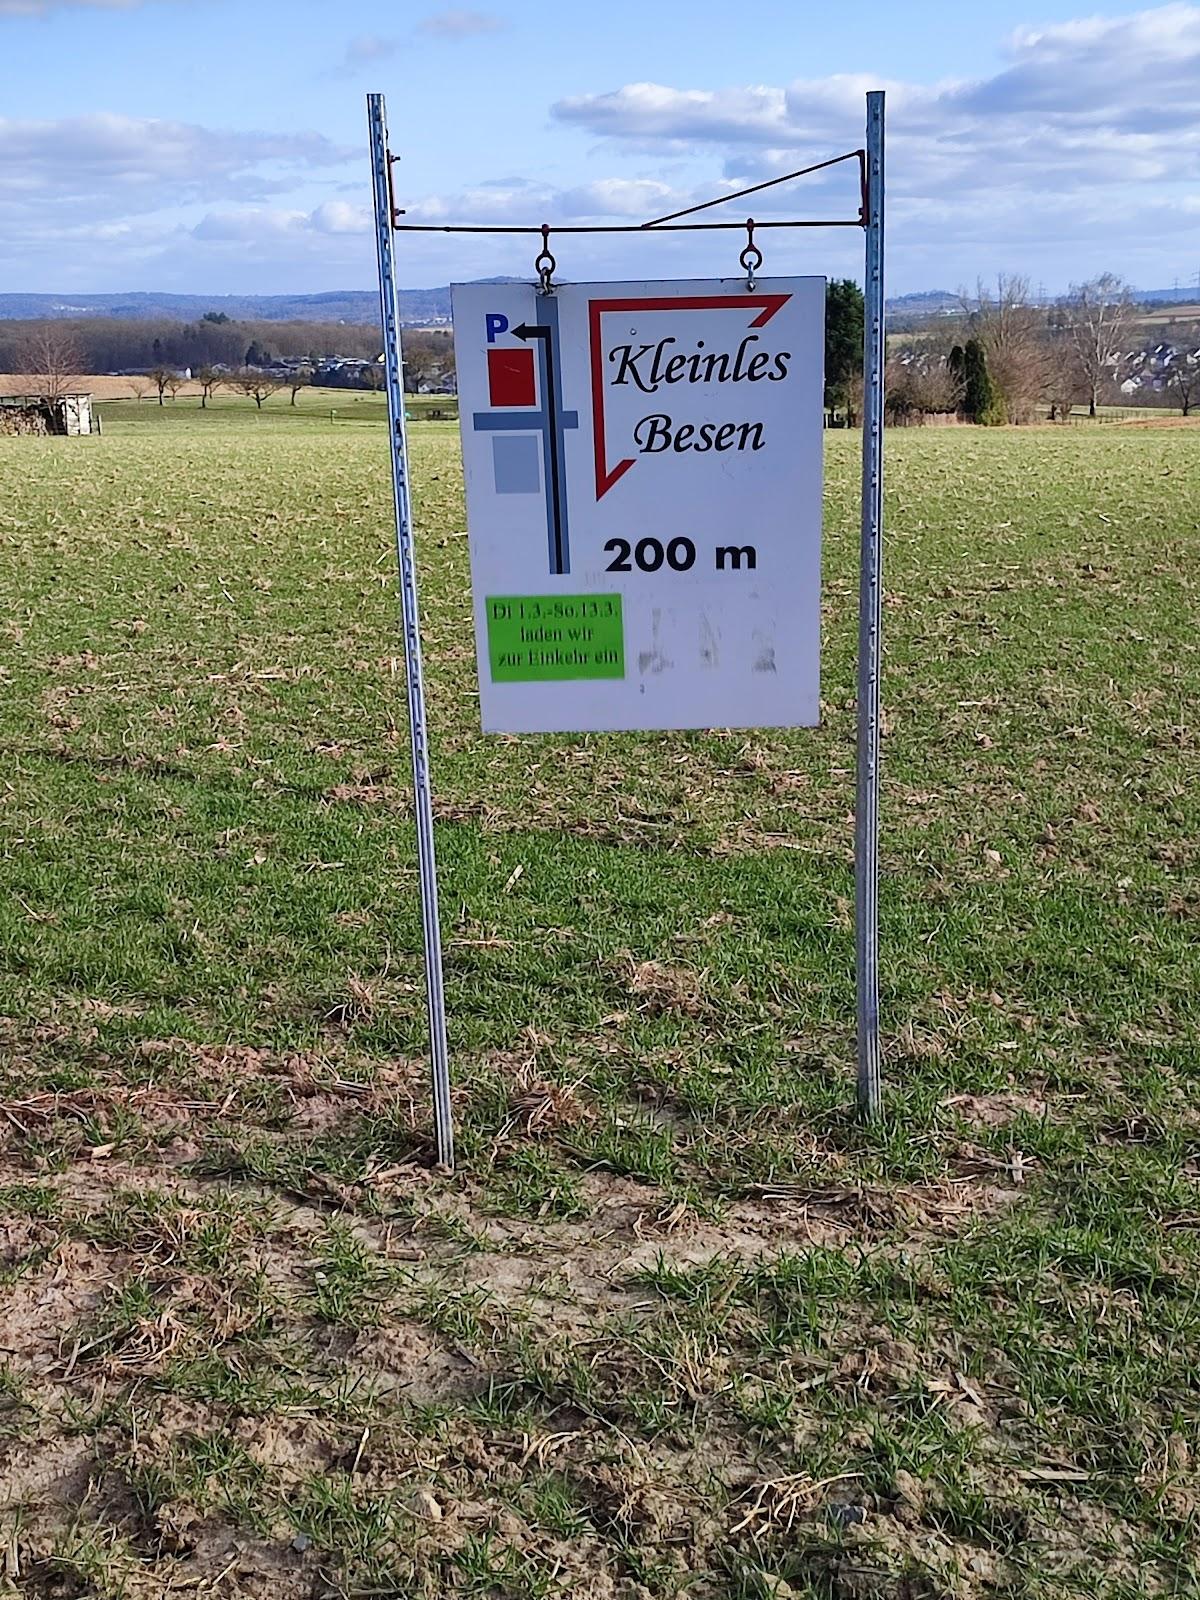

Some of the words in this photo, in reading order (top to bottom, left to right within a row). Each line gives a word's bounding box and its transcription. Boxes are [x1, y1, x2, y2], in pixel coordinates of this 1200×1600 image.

[485, 314, 509, 343] P
[608, 335, 791, 393] Kleinles
[634, 414, 766, 454] Besen
[603, 536, 697, 573] 200
[715, 545, 757, 570] m
[493, 602, 512, 620] Di
[521, 626, 562, 643] laden
[567, 626, 593, 642] wir
[498, 652, 521, 667] zur
[528, 647, 588, 667] Einkehr
[595, 647, 618, 665] ein
